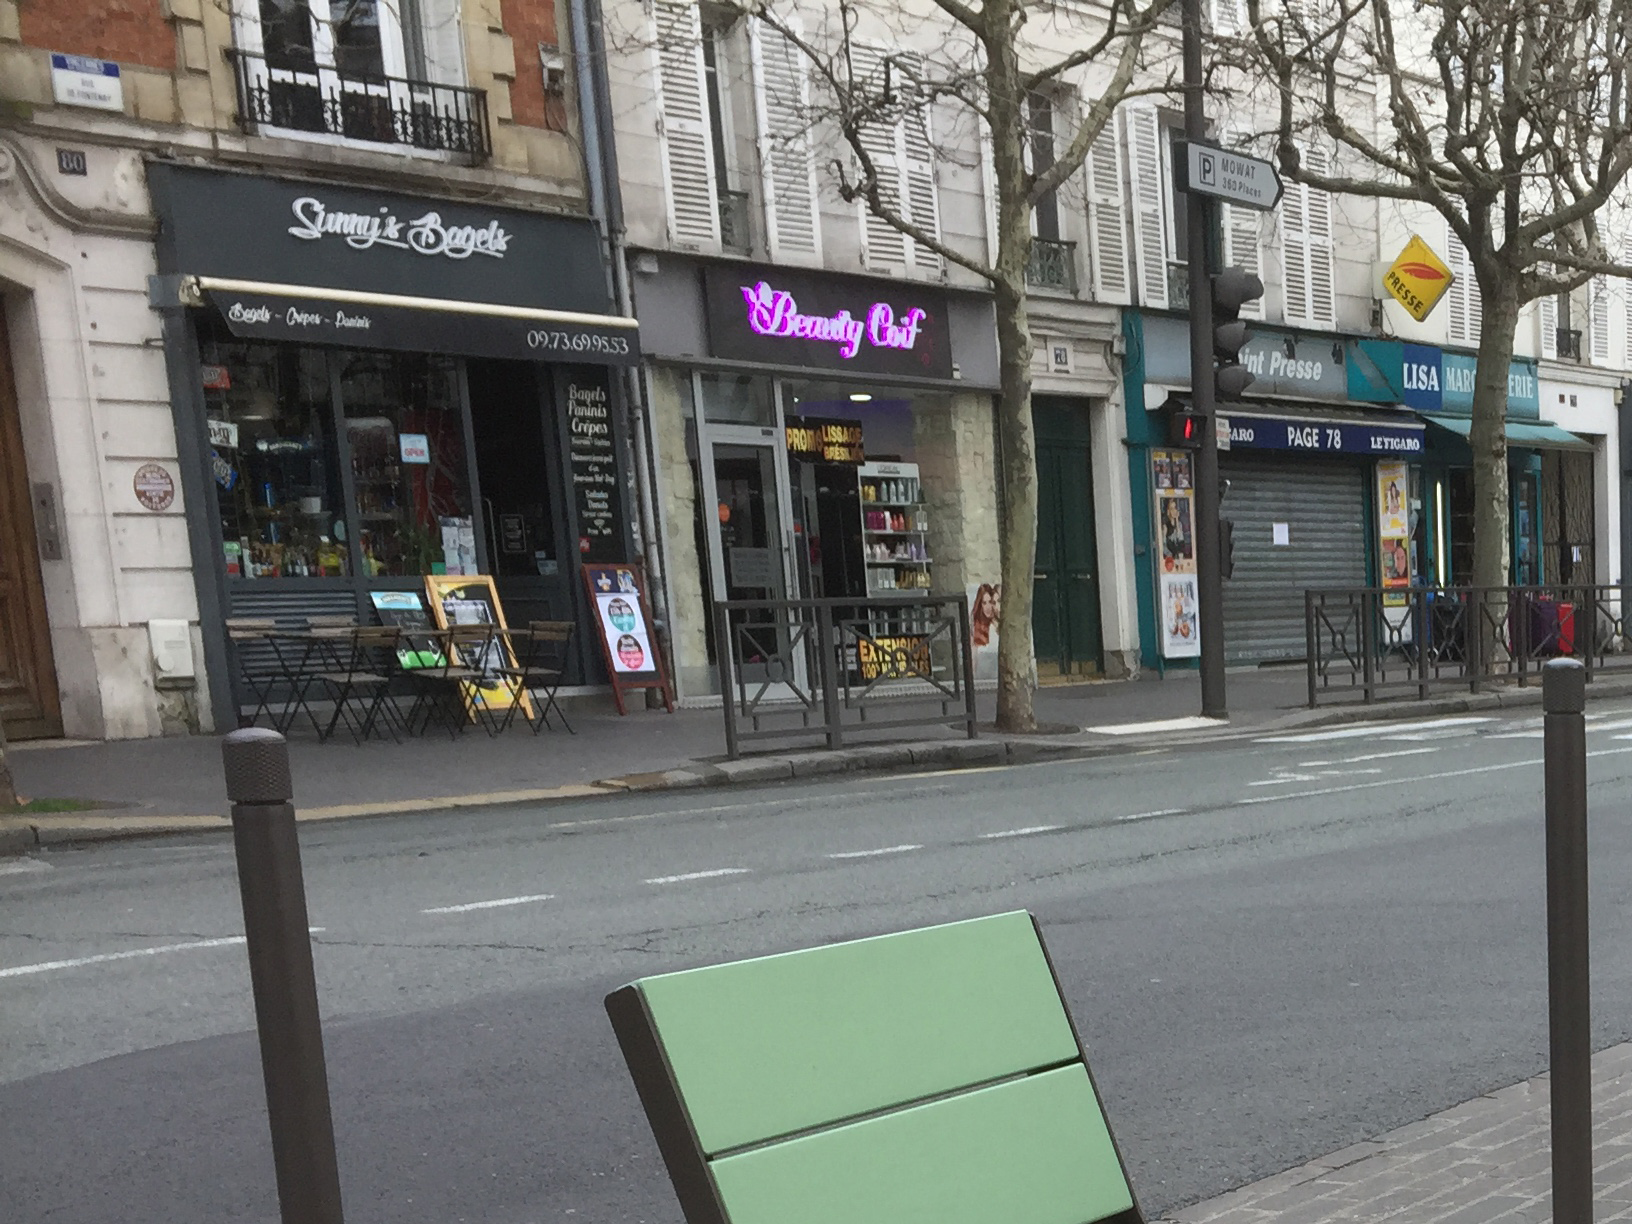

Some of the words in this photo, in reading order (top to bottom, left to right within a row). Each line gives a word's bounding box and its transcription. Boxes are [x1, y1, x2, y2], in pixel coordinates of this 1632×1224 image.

[61, 152, 84, 171] 80
[1221, 158, 1256, 180] MOWAT
[1223, 177, 1238, 192] 360
[1239, 181, 1262, 198] Places
[288, 197, 410, 249] Sunny's
[407, 211, 514, 259] Bagels
[1387, 271, 1425, 314] PRESSE
[229, 302, 272, 323] Bagels
[286, 306, 323, 327] Crêpes
[335, 310, 372, 330] Paninis
[740, 281, 865, 359] Beauty
[866, 302, 927, 350] Coif
[1269, 351, 1323, 382] Presse
[1402, 362, 1440, 392] LISA
[568, 383, 606, 405] Bagels
[567, 399, 607, 418] Paninis
[571, 417, 608, 437] Crêpes
[1288, 426, 1320, 449] PAGE
[1326, 428, 1342, 450] 78
[1383, 435, 1421, 451] FIGARO
